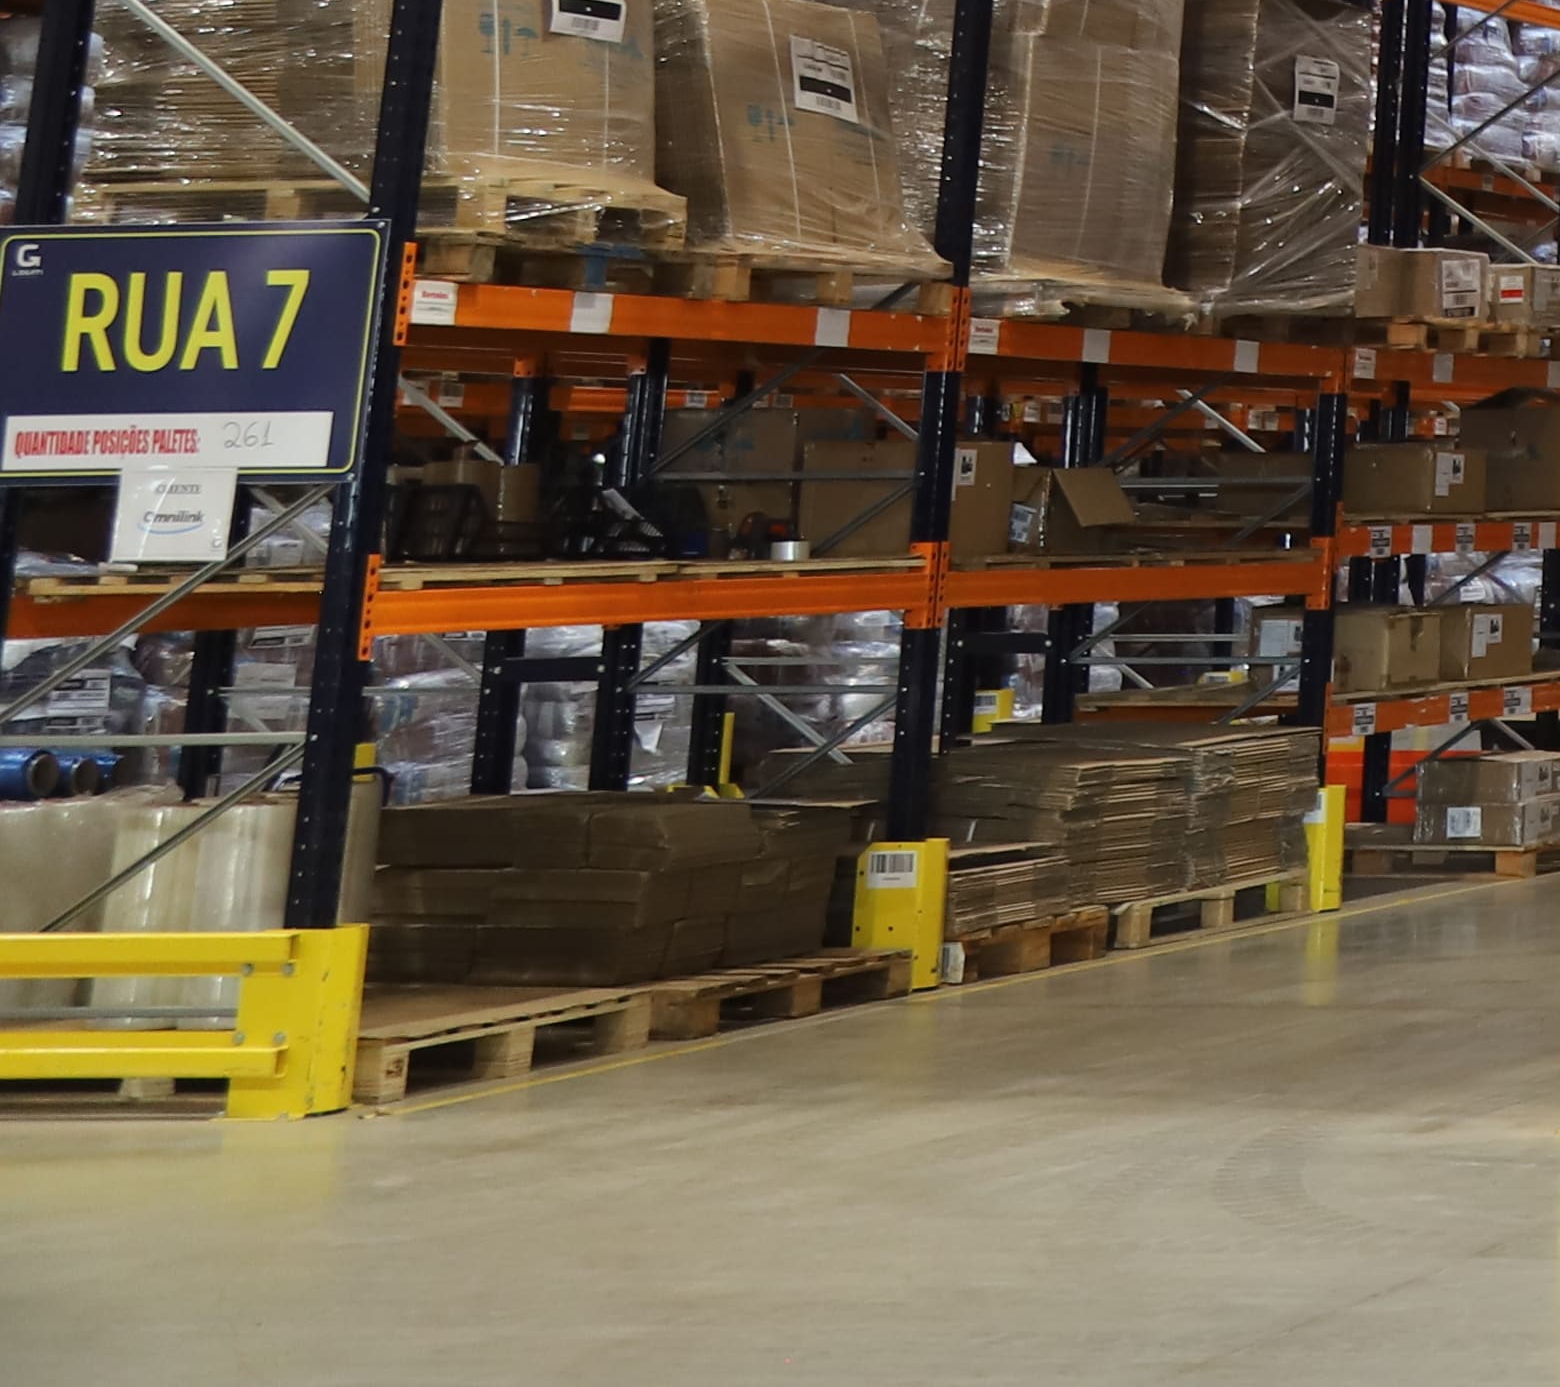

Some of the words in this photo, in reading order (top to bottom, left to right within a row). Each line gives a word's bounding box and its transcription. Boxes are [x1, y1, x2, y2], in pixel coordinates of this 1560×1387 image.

[16, 244, 41, 268] G
[61, 271, 239, 372] RUA
[262, 270, 310, 369] 7
[15, 429, 91, 458] QUANTIDADE
[93, 424, 149, 459] POSIÇÕES
[152, 429, 200, 455] PALETES:
[223, 420, 275, 449] 261
[143, 511, 204, 525] Omnilink
